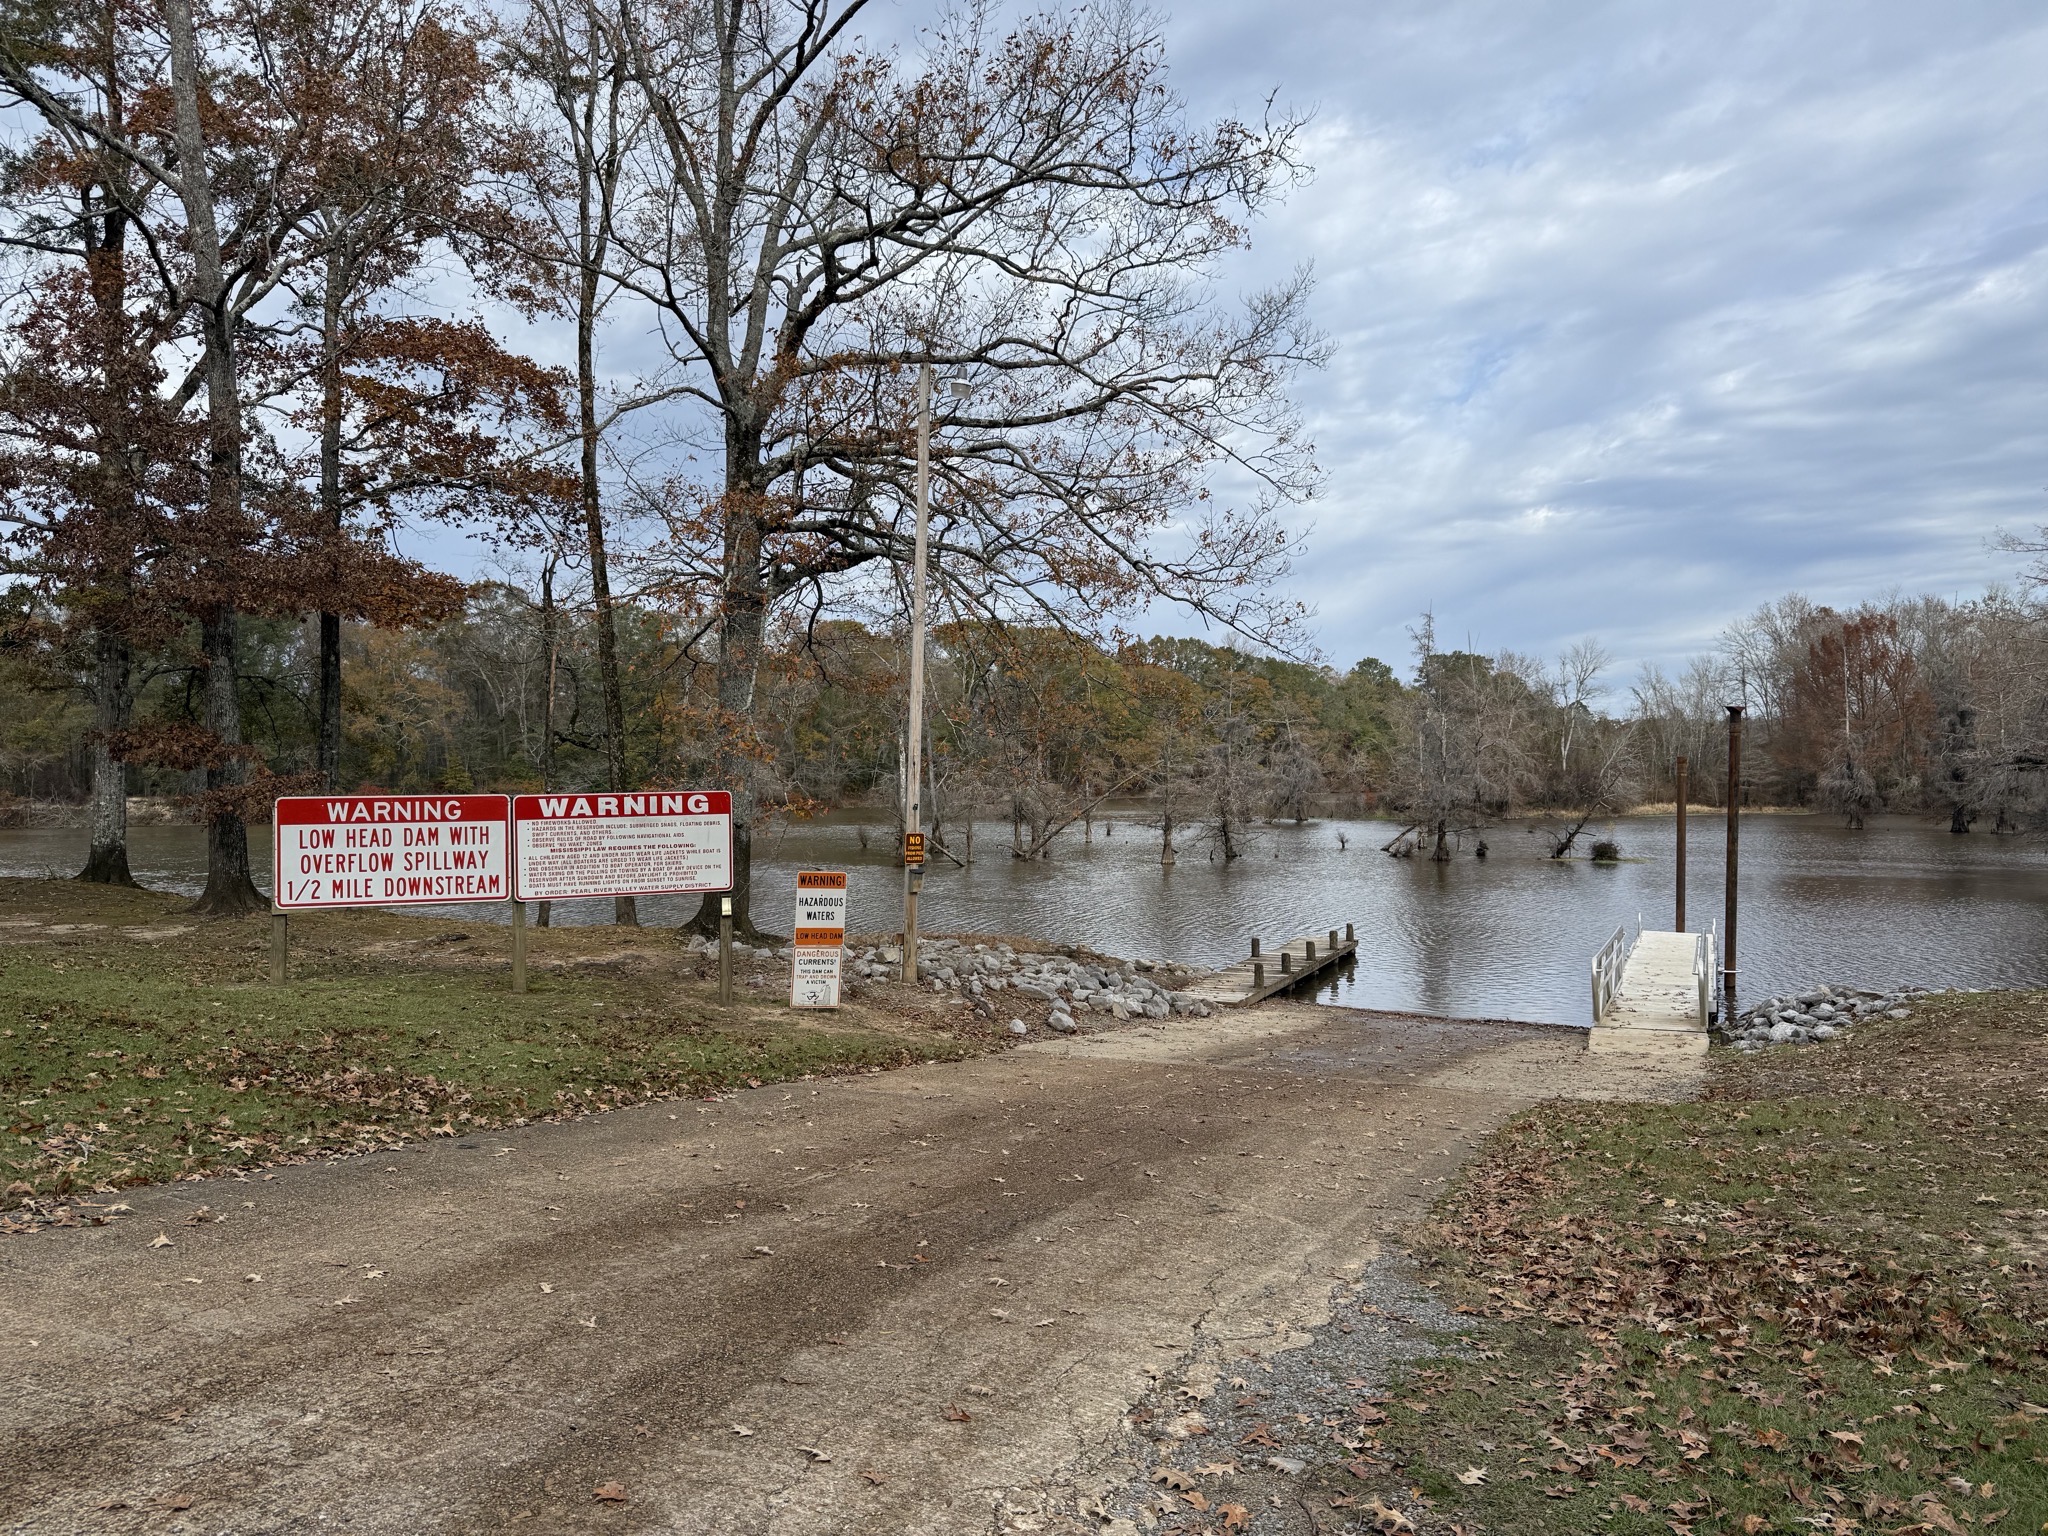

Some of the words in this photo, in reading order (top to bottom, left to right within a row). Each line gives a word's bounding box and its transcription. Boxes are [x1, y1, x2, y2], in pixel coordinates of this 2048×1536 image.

[327, 801, 461, 822] WARNING
[538, 794, 709, 817] WARNING
[300, 830, 335, 849] LOW
[346, 828, 392, 848] HEAD
[404, 827, 438, 846] DAM
[450, 826, 489, 845] WITH
[300, 853, 393, 874] OVERFLOW
[404, 851, 488, 871] SPILLWAY
[288, 879, 320, 901] 1/2
[332, 878, 373, 899] MILE
[384, 875, 499, 897] DOWNSTREAM
[800, 876, 845, 886] WARNING!
[799, 898, 843, 906] HAZARDOUS
[807, 912, 834, 920] WATERS
